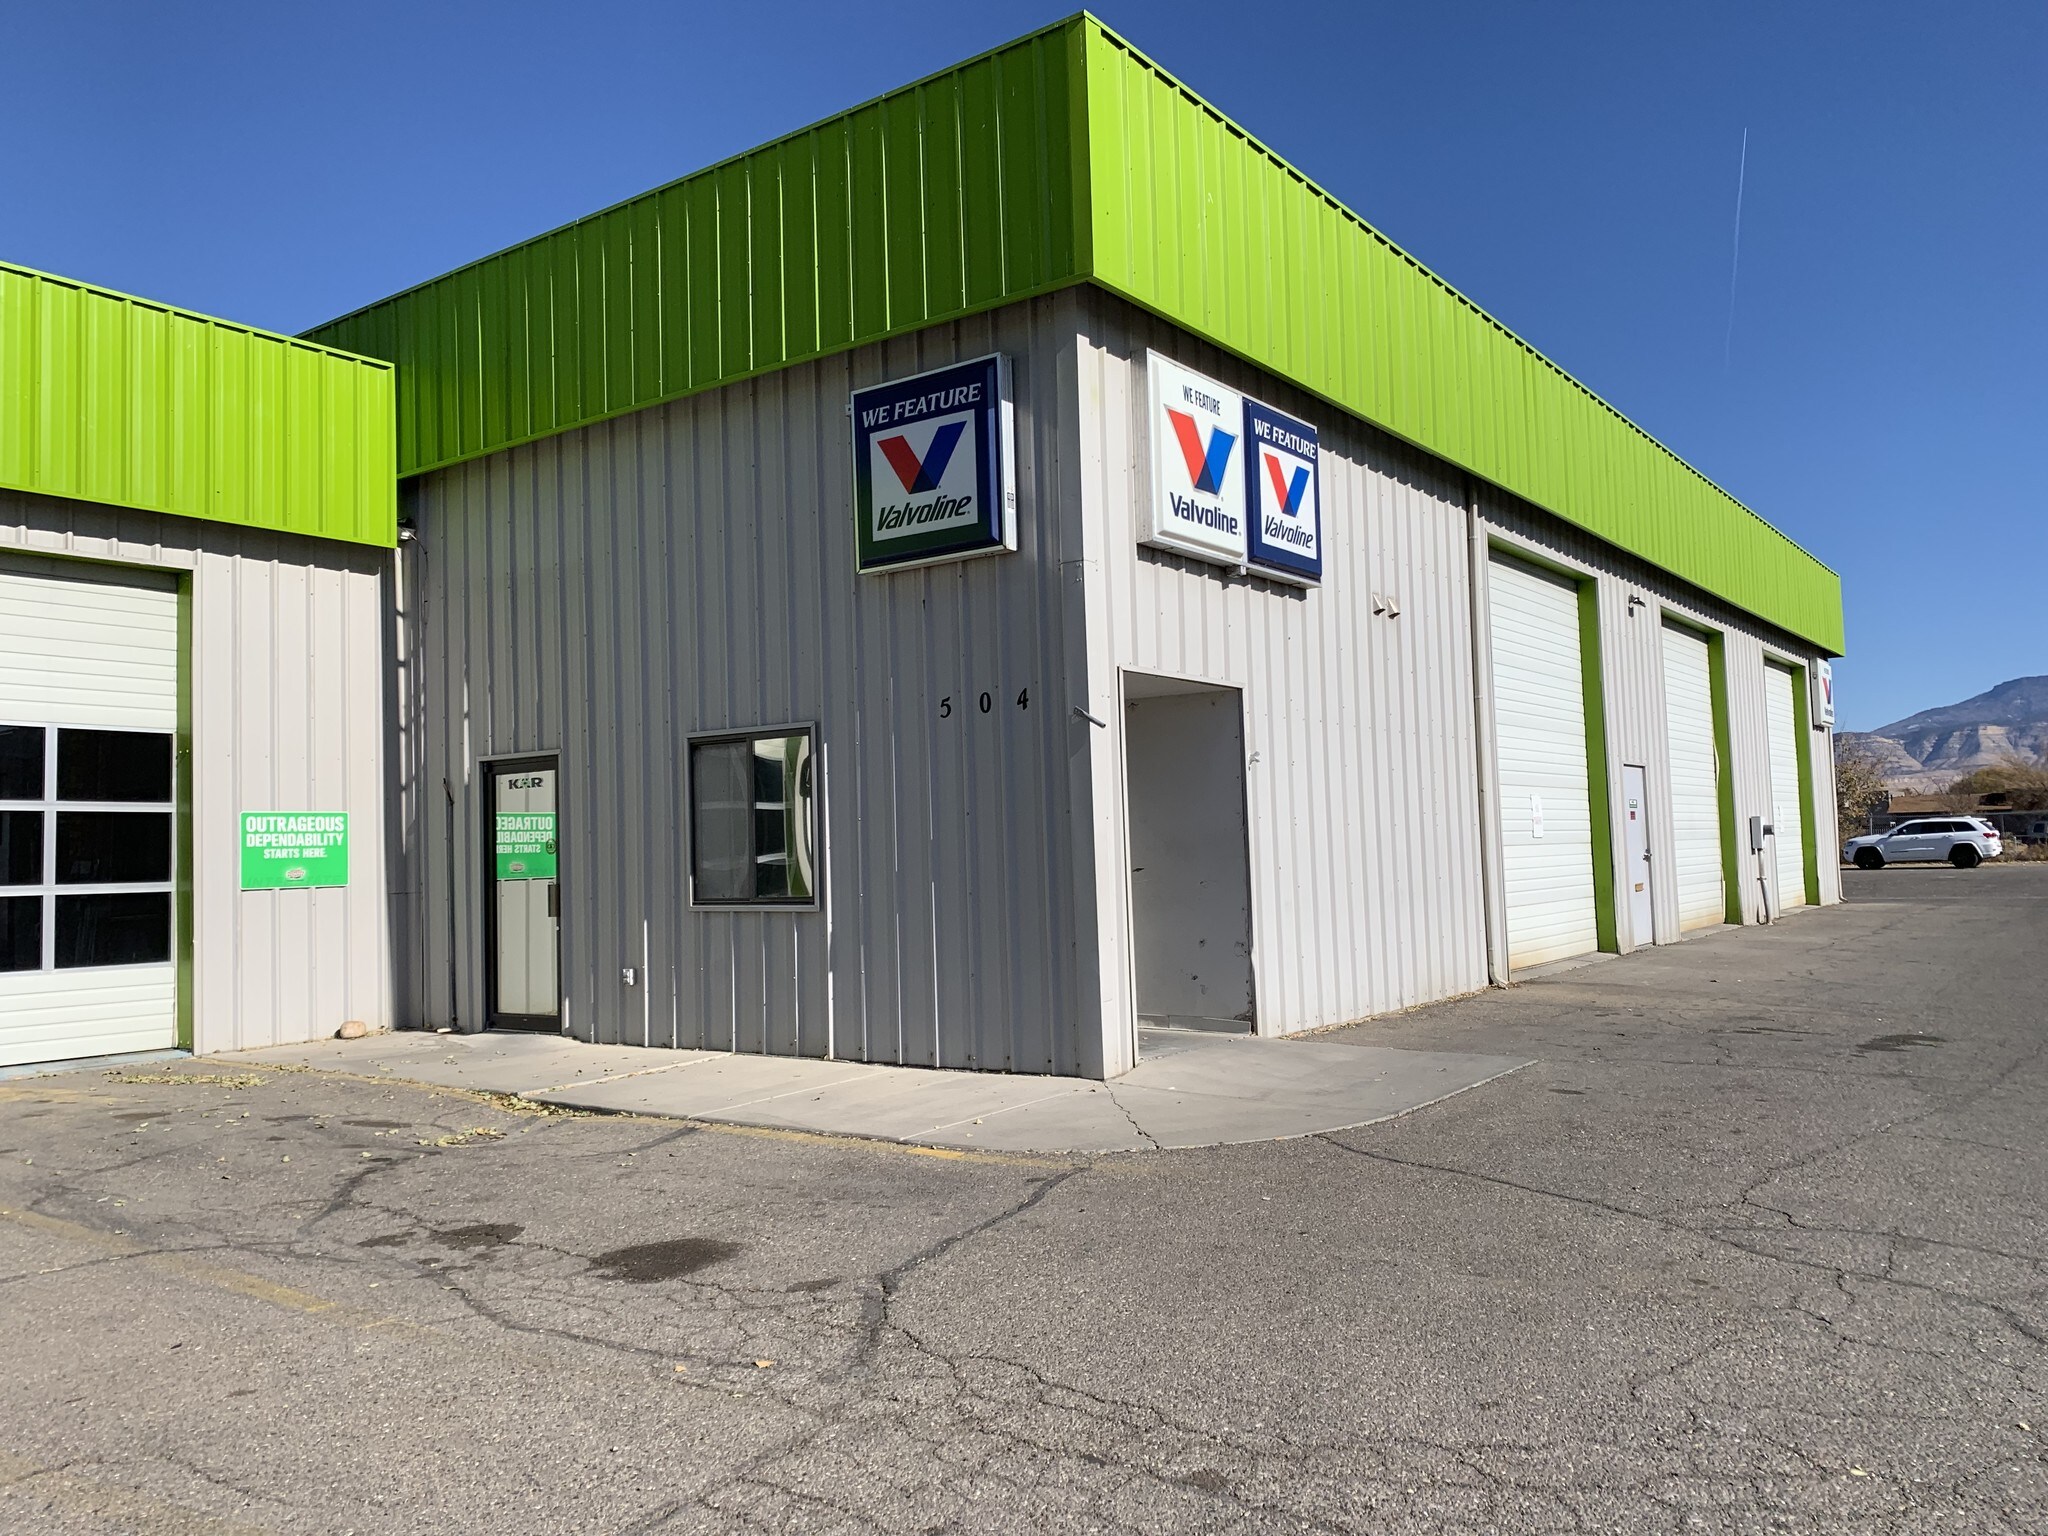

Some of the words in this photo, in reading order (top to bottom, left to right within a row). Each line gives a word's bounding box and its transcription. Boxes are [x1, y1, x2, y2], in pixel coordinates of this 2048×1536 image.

[862, 405, 890, 428] WE
[893, 383, 982, 421] FEATURE
[1182, 384, 1193, 404] WE
[1194, 390, 1221, 416] FEATURE
[1253, 418, 1271, 440] WE
[1272, 427, 1317, 460] FEATURE
[876, 494, 972, 531] Valvoline
[1169, 491, 1239, 536] Valvoline
[1264, 514, 1314, 549] Valvoline
[245, 816, 345, 832] OUTRAGEOUS
[246, 833, 345, 847] DEPENDABILITY
[263, 849, 300, 859] STARTS
[302, 848, 328, 858] HERE.
